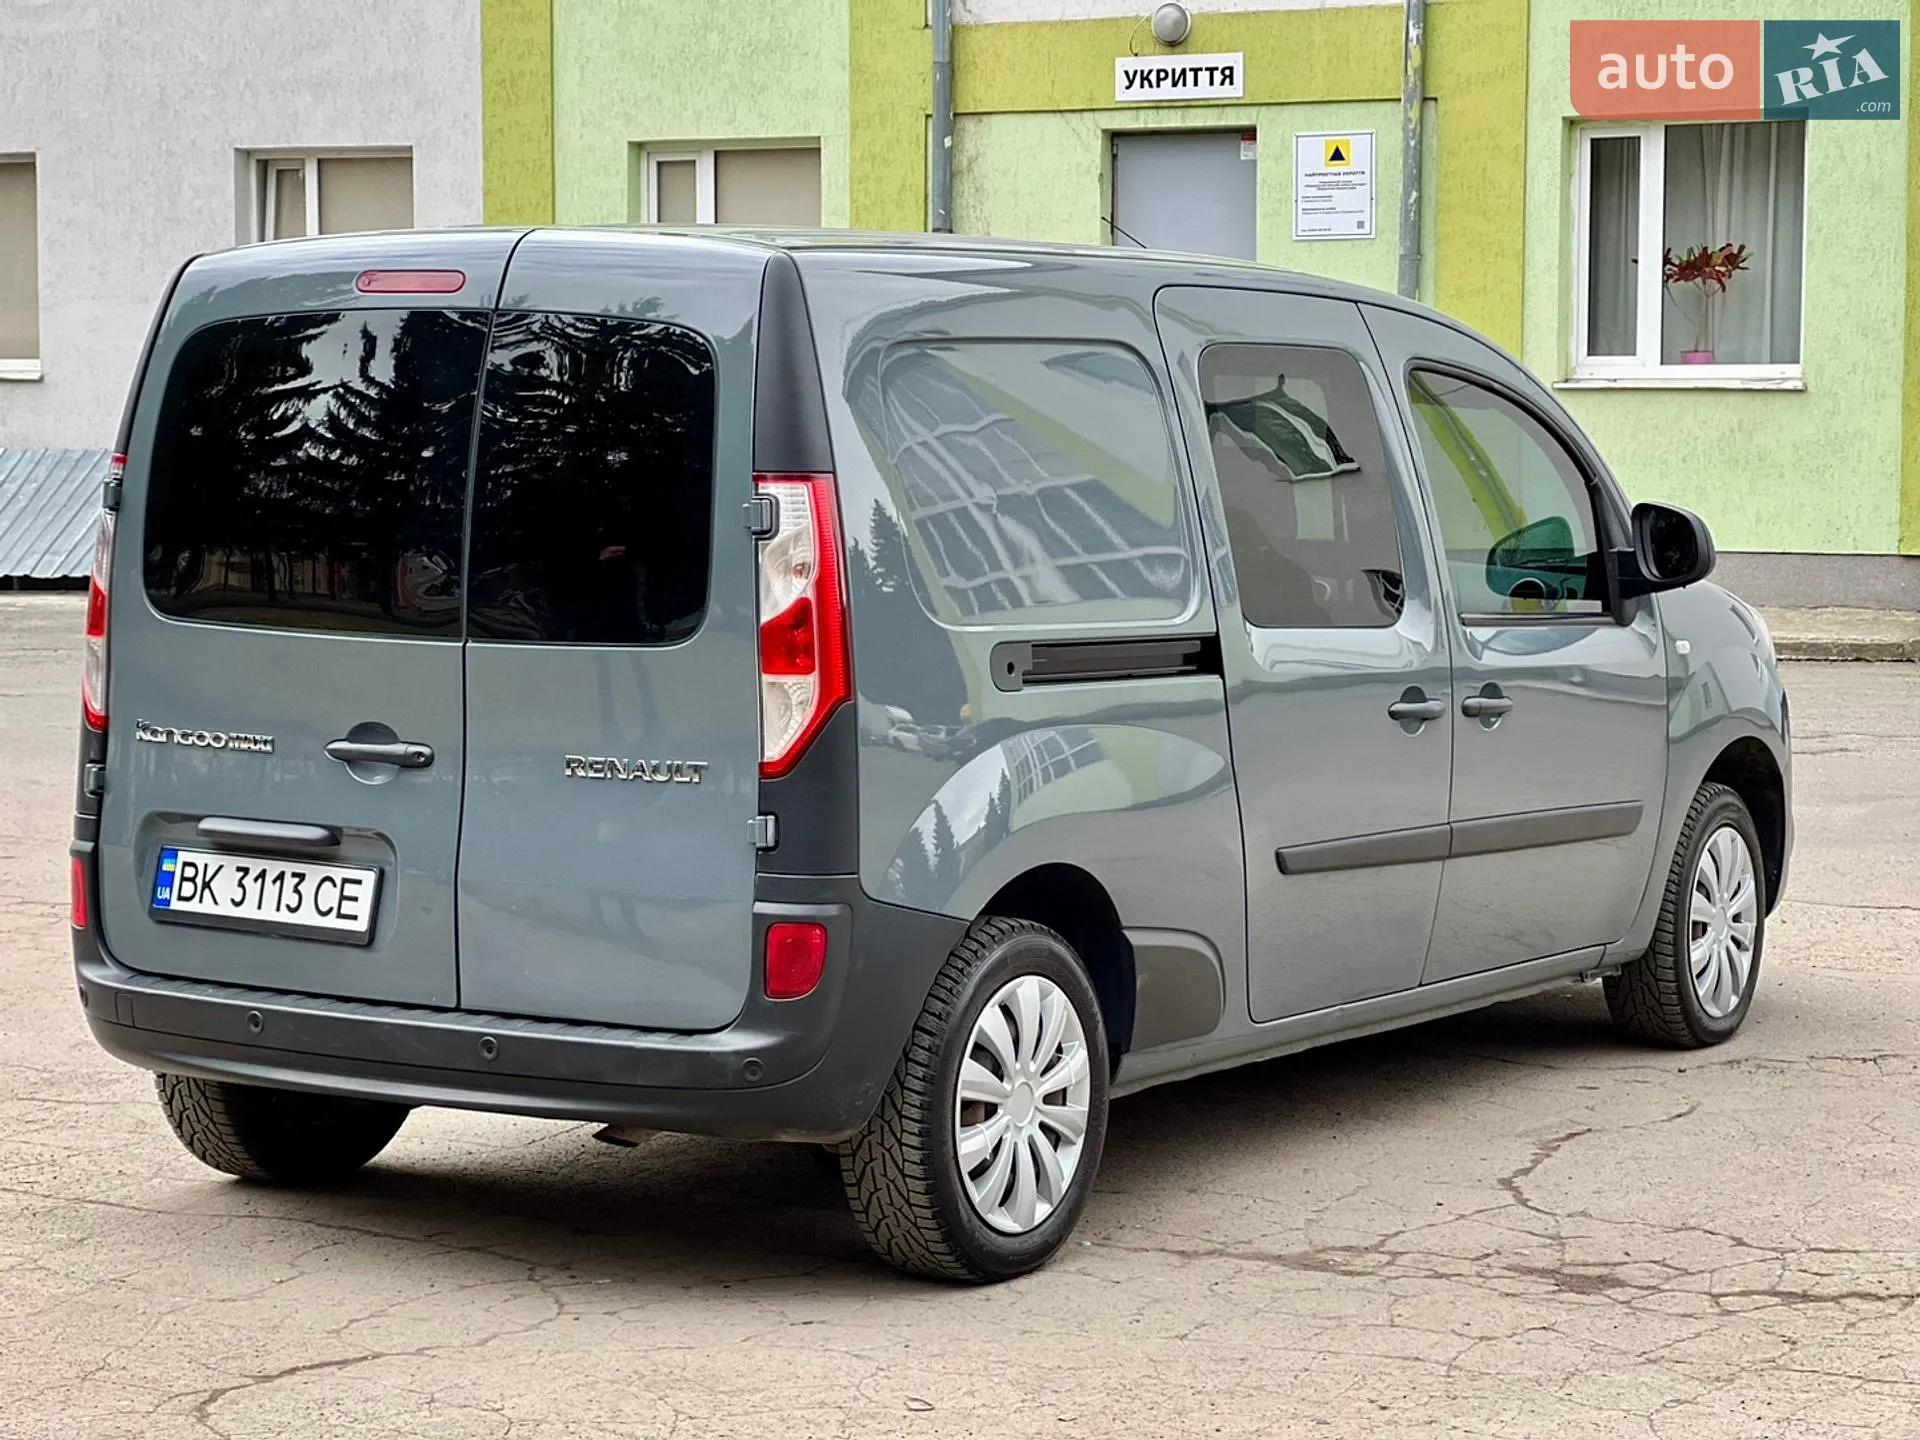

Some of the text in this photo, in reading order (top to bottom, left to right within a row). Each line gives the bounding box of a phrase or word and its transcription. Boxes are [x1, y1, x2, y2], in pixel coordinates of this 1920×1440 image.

[1123, 66, 1234, 90] УКРИТТЯ
[563, 754, 709, 784] RENAULT
[157, 886, 170, 900] UA
[230, 866, 306, 914] 3113
